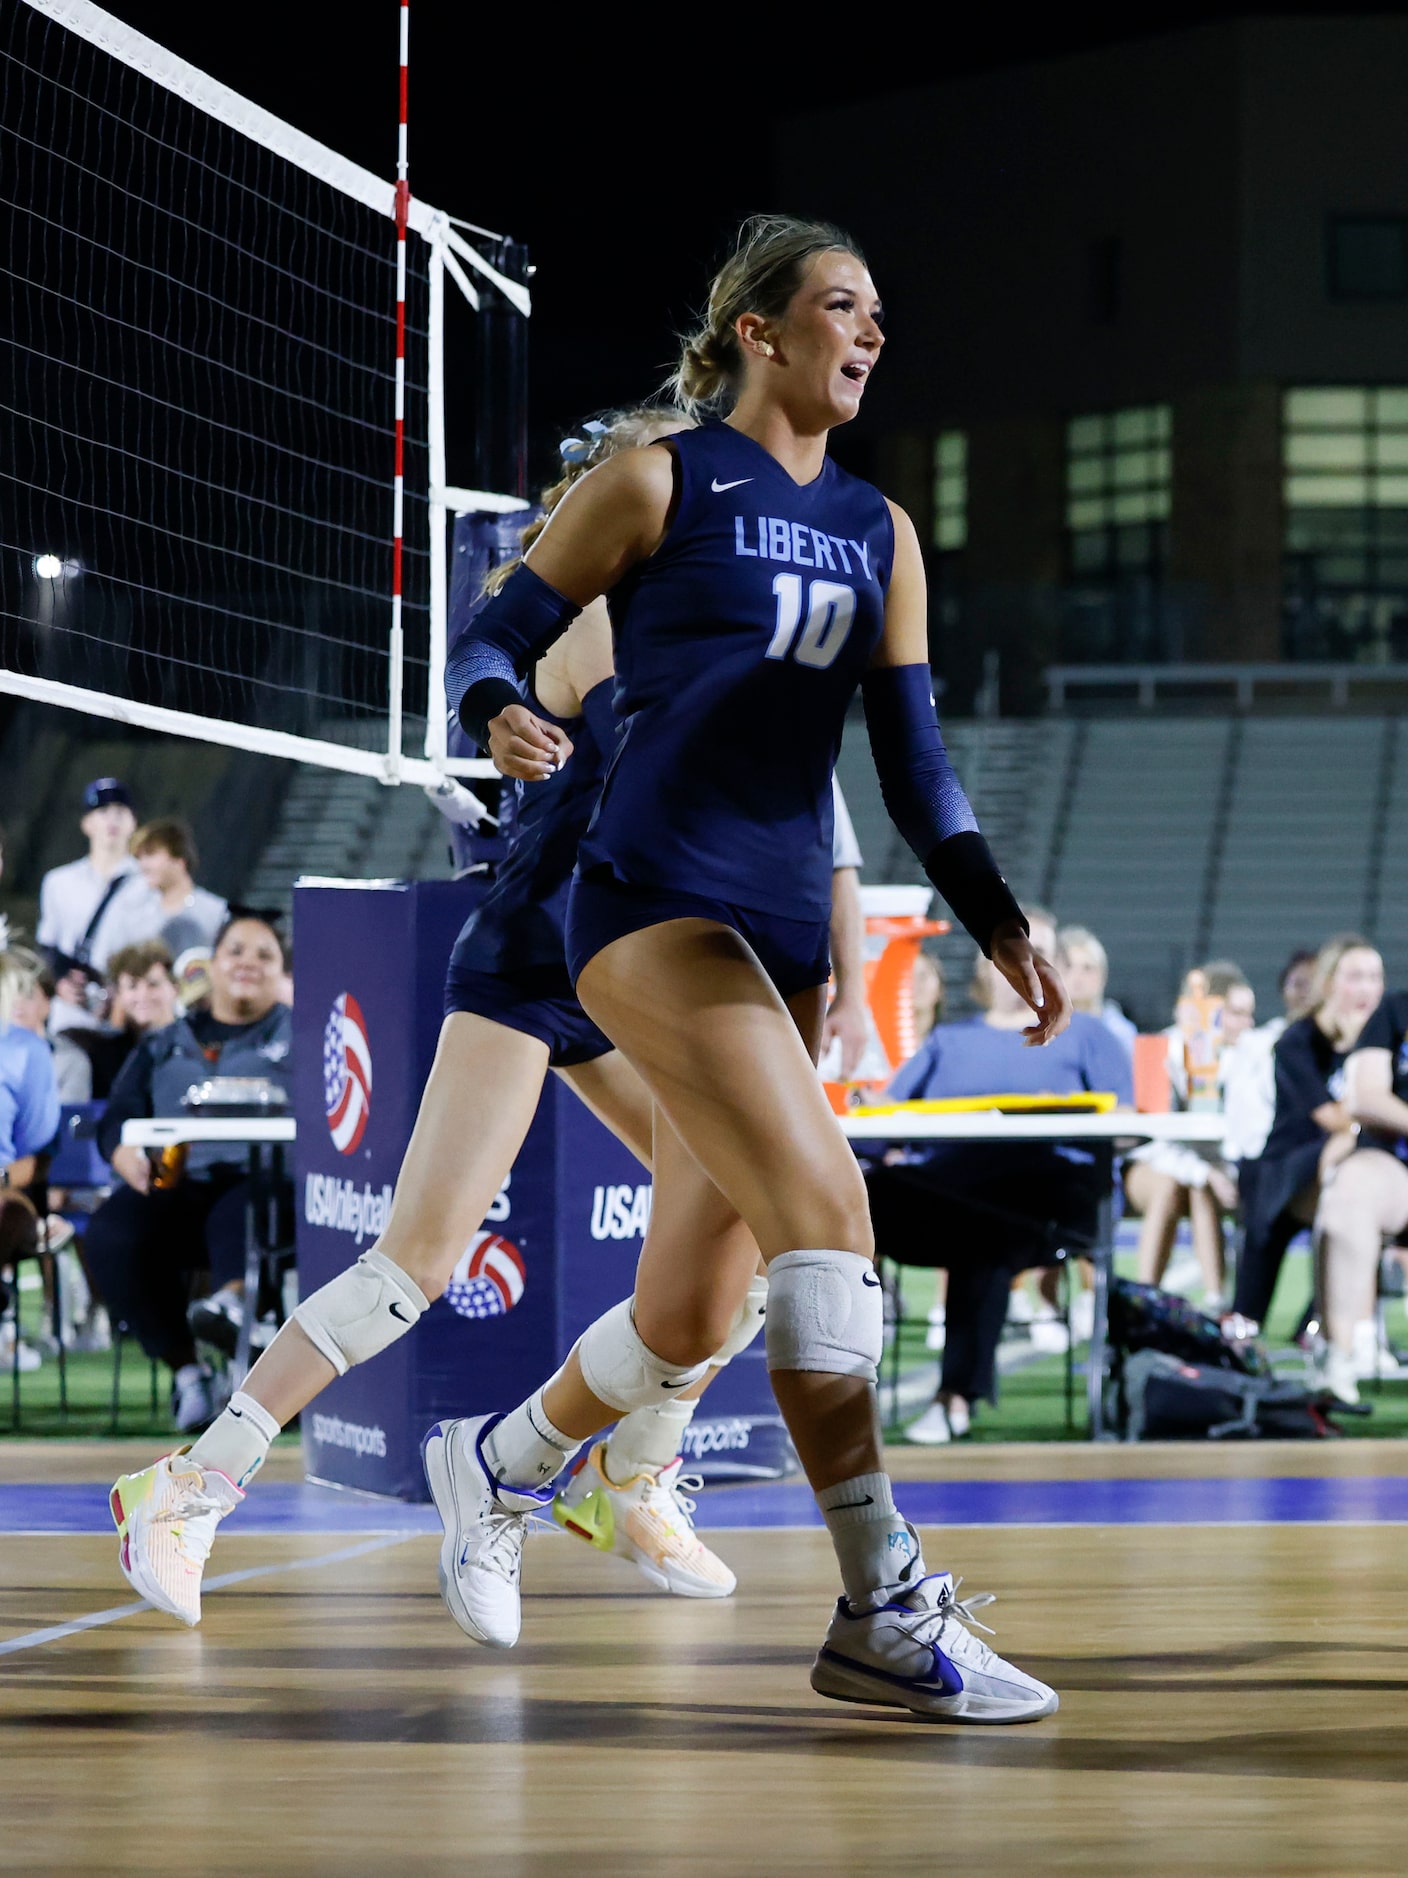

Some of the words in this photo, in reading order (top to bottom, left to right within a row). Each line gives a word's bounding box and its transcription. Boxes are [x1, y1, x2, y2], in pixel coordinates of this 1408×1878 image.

[735, 515, 872, 581] LIBERTY
[765, 572, 856, 670] 10
[591, 1185, 653, 1240] USA
